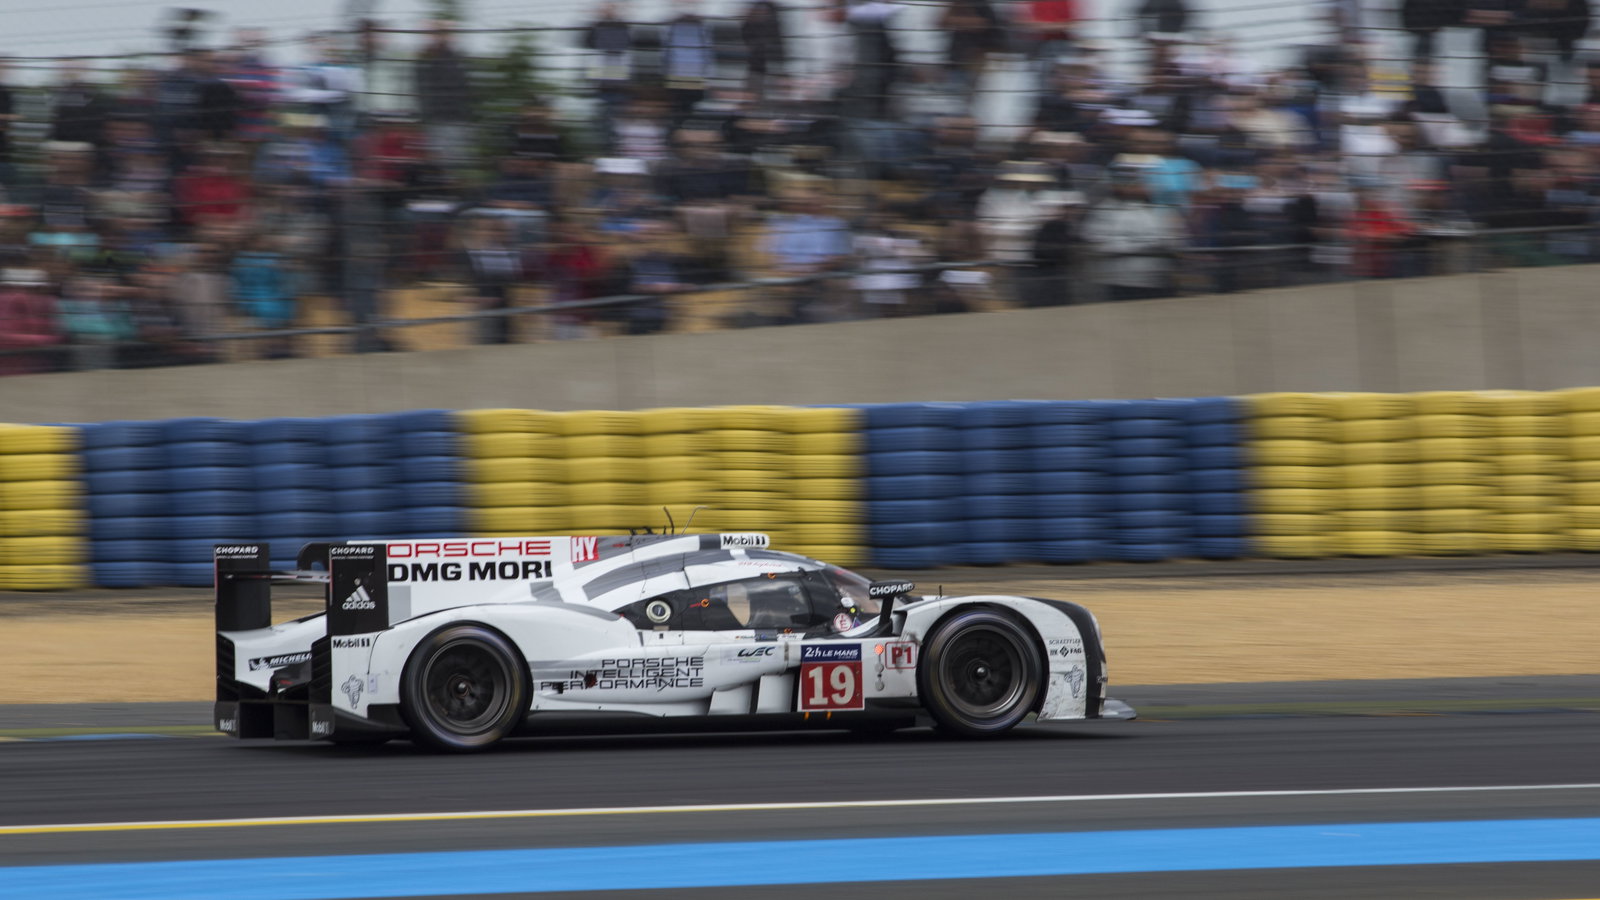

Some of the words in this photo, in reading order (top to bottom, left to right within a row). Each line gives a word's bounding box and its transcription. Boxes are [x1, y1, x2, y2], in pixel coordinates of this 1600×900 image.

[723, 536, 753, 545] Mobil
[215, 546, 259, 554] CHOPARD
[331, 546, 374, 555] CHOPARD
[387, 541, 551, 558] ORSCHE
[571, 536, 597, 562] HY
[387, 562, 462, 582] DMG
[469, 560, 552, 581] MORI
[869, 583, 914, 595] CHOPARD
[342, 601, 376, 610] adidas
[333, 638, 359, 648] Mobil
[737, 646, 776, 657] WEC
[891, 646, 912, 664] P1
[601, 656, 704, 668] PORSCHE
[570, 667, 704, 680] INTELLIGENT
[808, 665, 855, 706] 19
